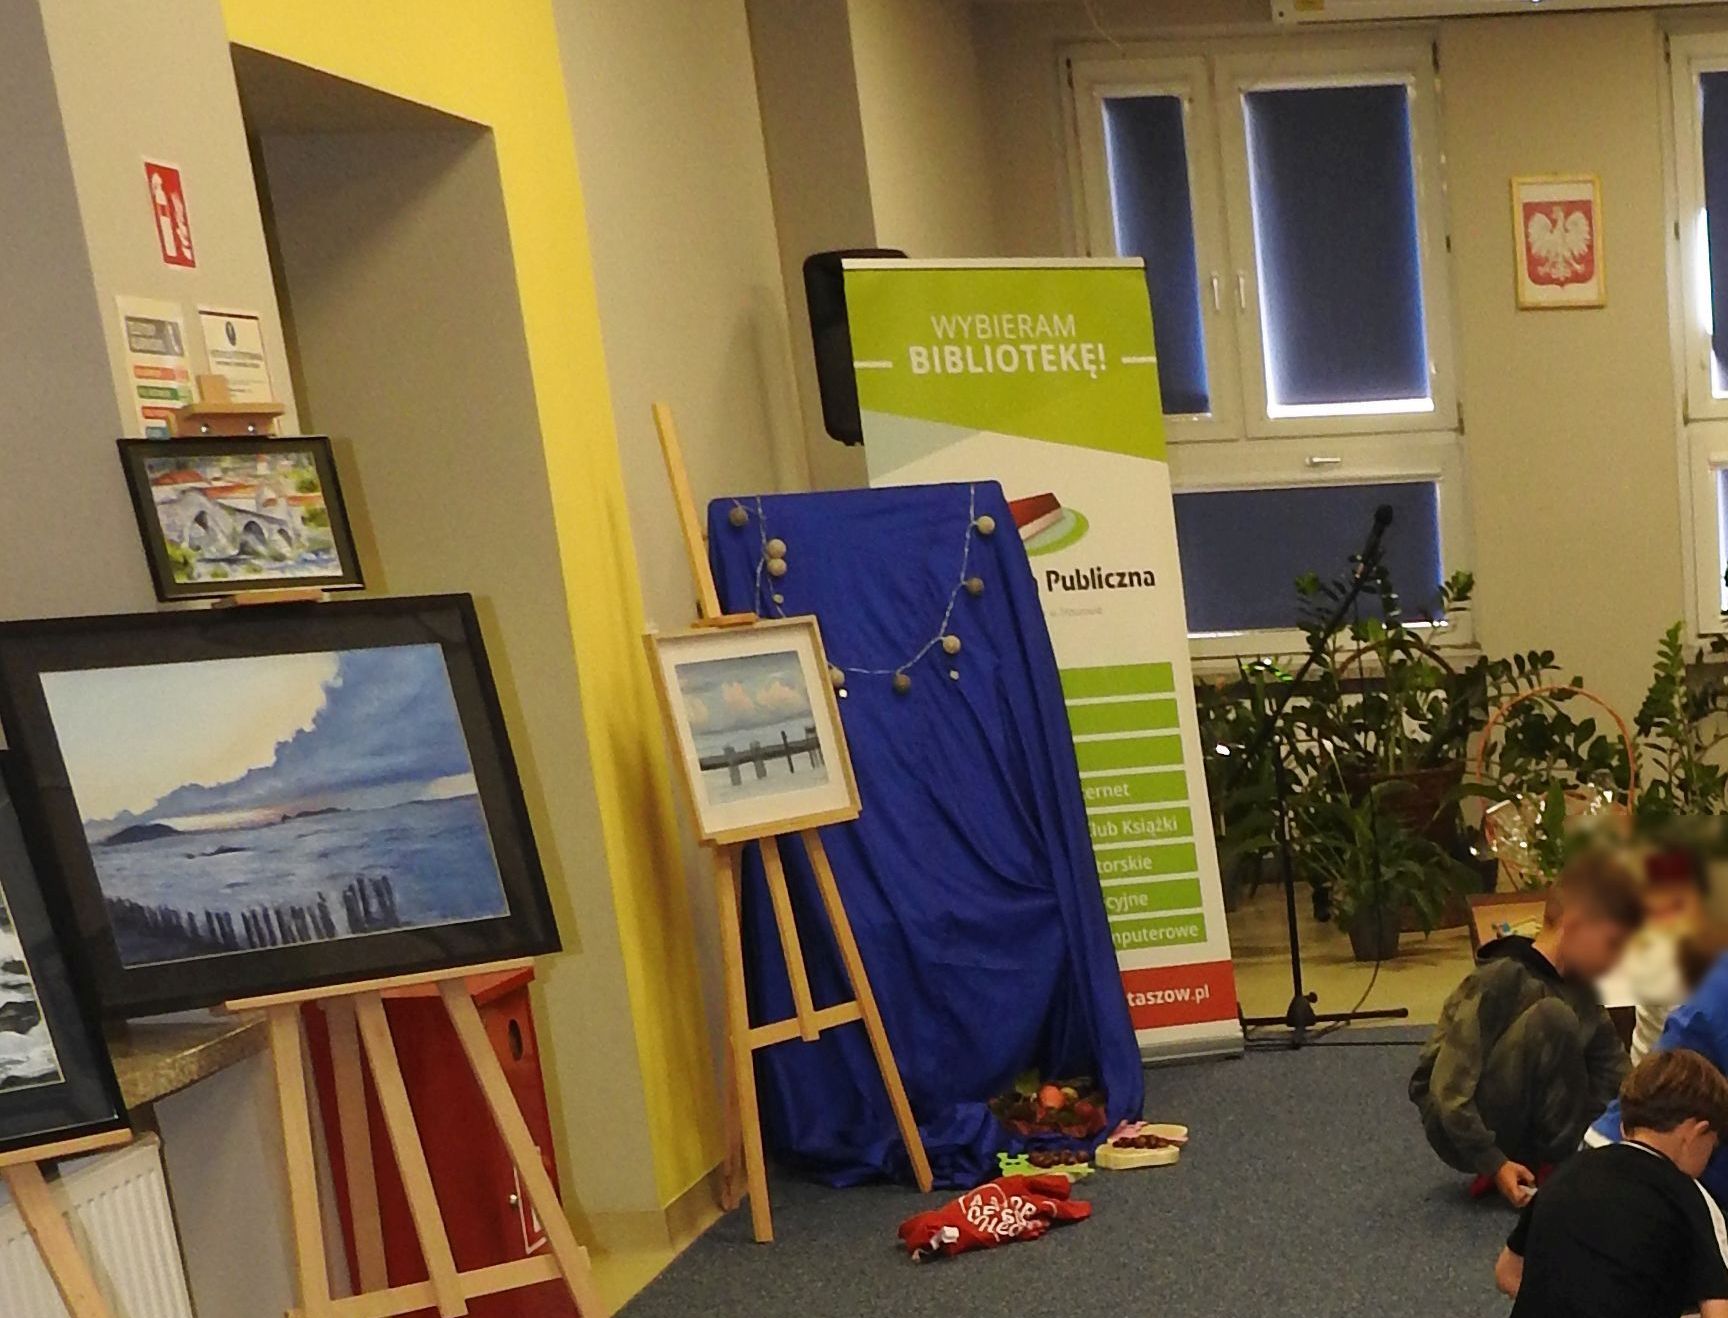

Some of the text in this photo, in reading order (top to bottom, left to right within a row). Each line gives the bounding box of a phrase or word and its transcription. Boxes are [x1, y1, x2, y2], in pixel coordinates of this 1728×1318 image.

[931, 314, 1076, 340] WYBIERAM
[908, 343, 1106, 379] BIBLIOTEKĘ!
[1045, 566, 1156, 592] Publiczna
[1083, 783, 1131, 800] ernet
[1090, 817, 1178, 837] lub Książki
[1126, 984, 1210, 1007] taszow.pl
